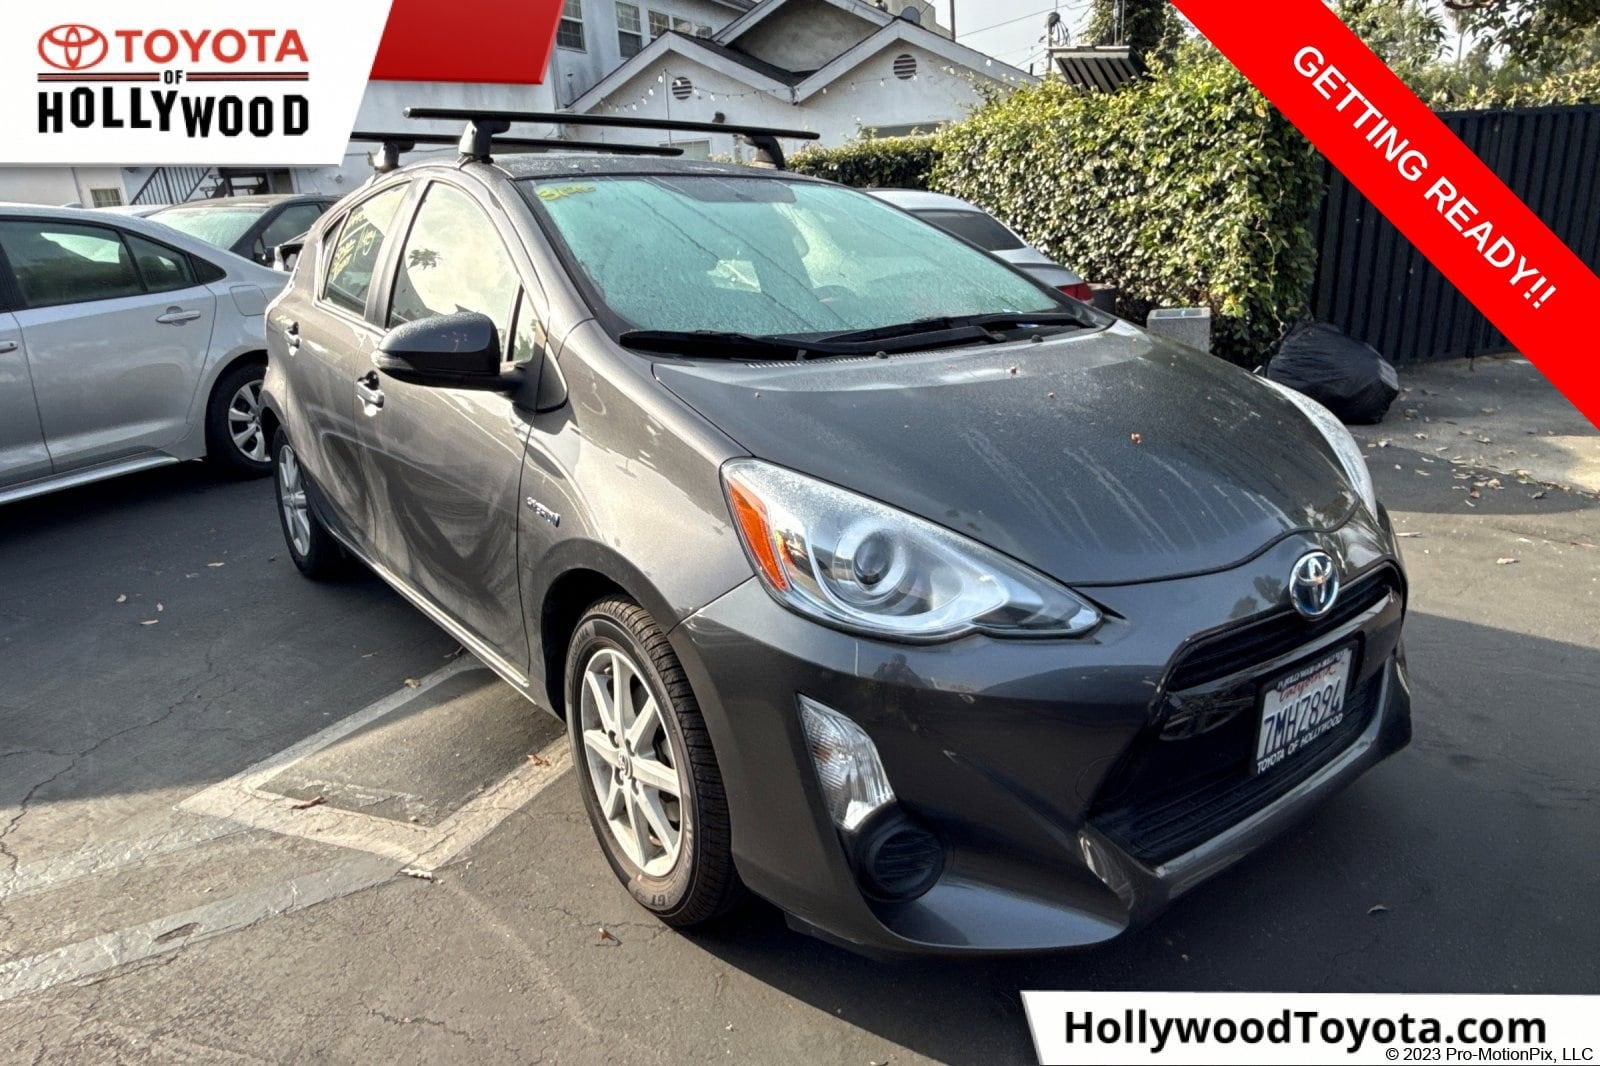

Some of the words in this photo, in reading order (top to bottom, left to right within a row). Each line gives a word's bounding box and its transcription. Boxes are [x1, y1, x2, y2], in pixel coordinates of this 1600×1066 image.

[1257, 748, 1285, 775] TOYOTA
[1287, 738, 1300, 756] OF
[1300, 712, 1344, 749] HOLLYWOOD
[1263, 679, 1342, 757] 7MHZ894
